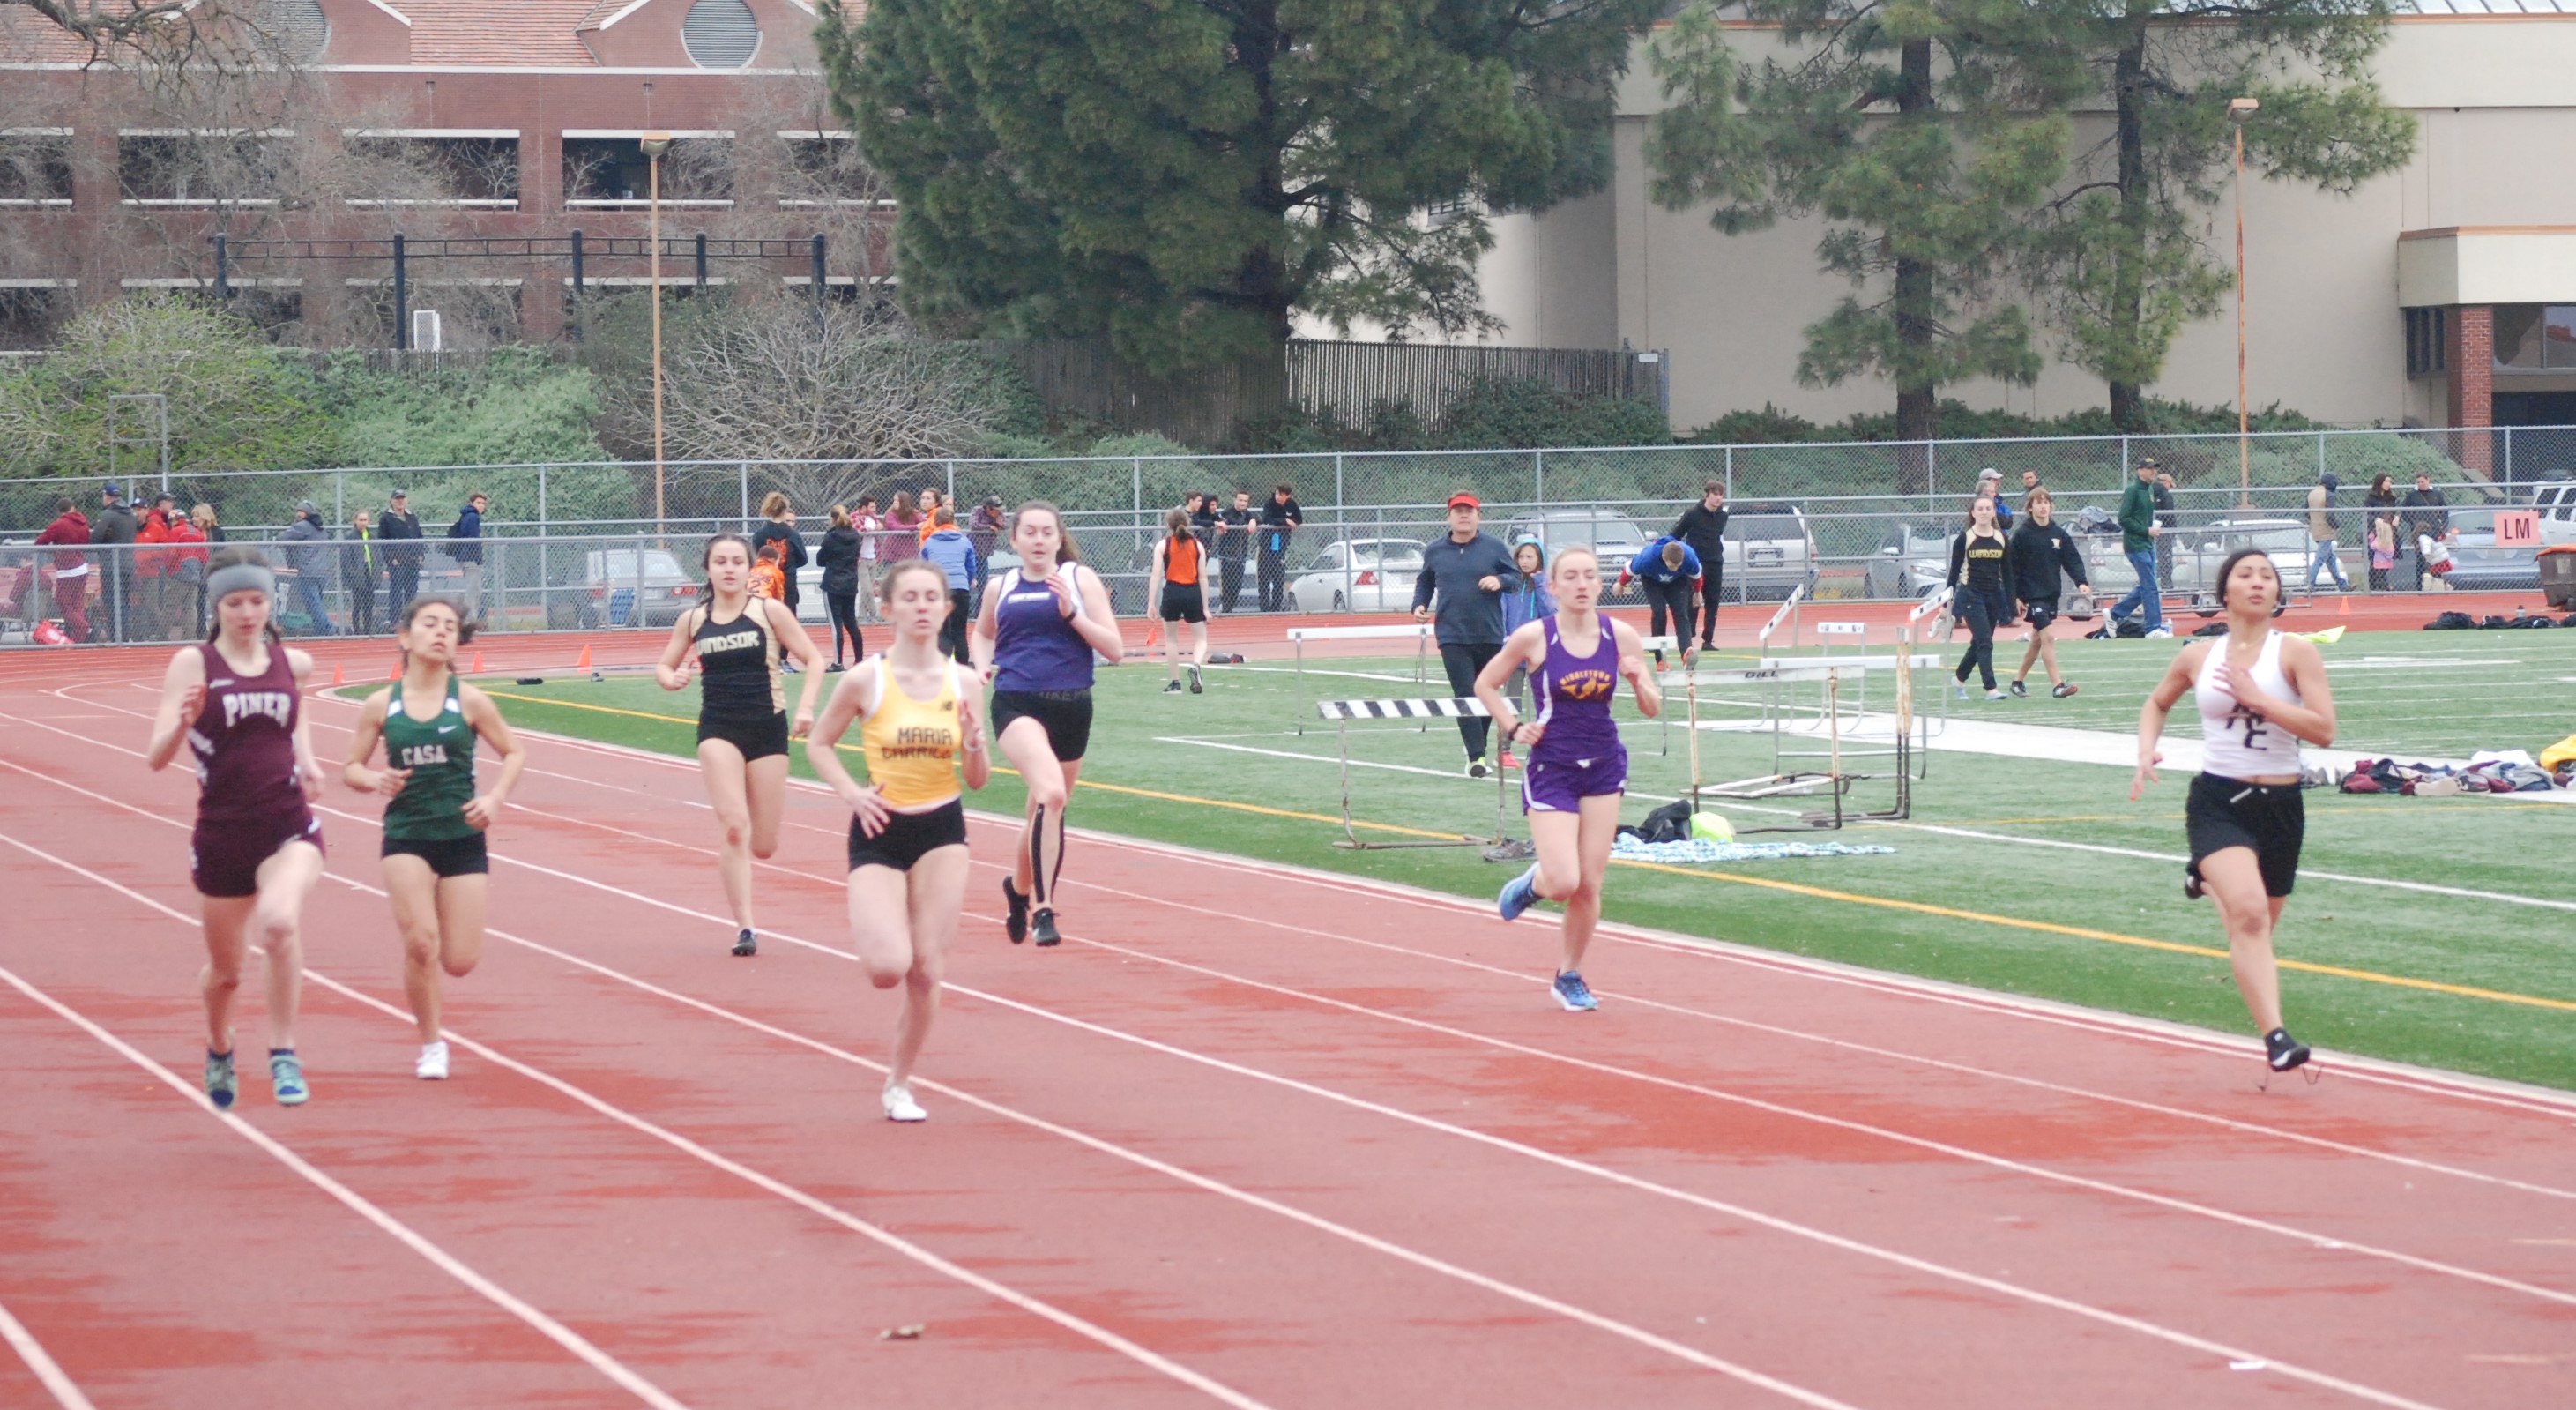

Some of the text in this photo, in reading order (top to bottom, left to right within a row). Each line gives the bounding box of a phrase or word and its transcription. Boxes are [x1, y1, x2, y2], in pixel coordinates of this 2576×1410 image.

[2504, 518, 2530, 540] LM
[1744, 670, 1779, 679] GILL
[222, 692, 291, 728] PINER
[897, 727, 952, 746] MARIA
[401, 744, 448, 766] CASA
